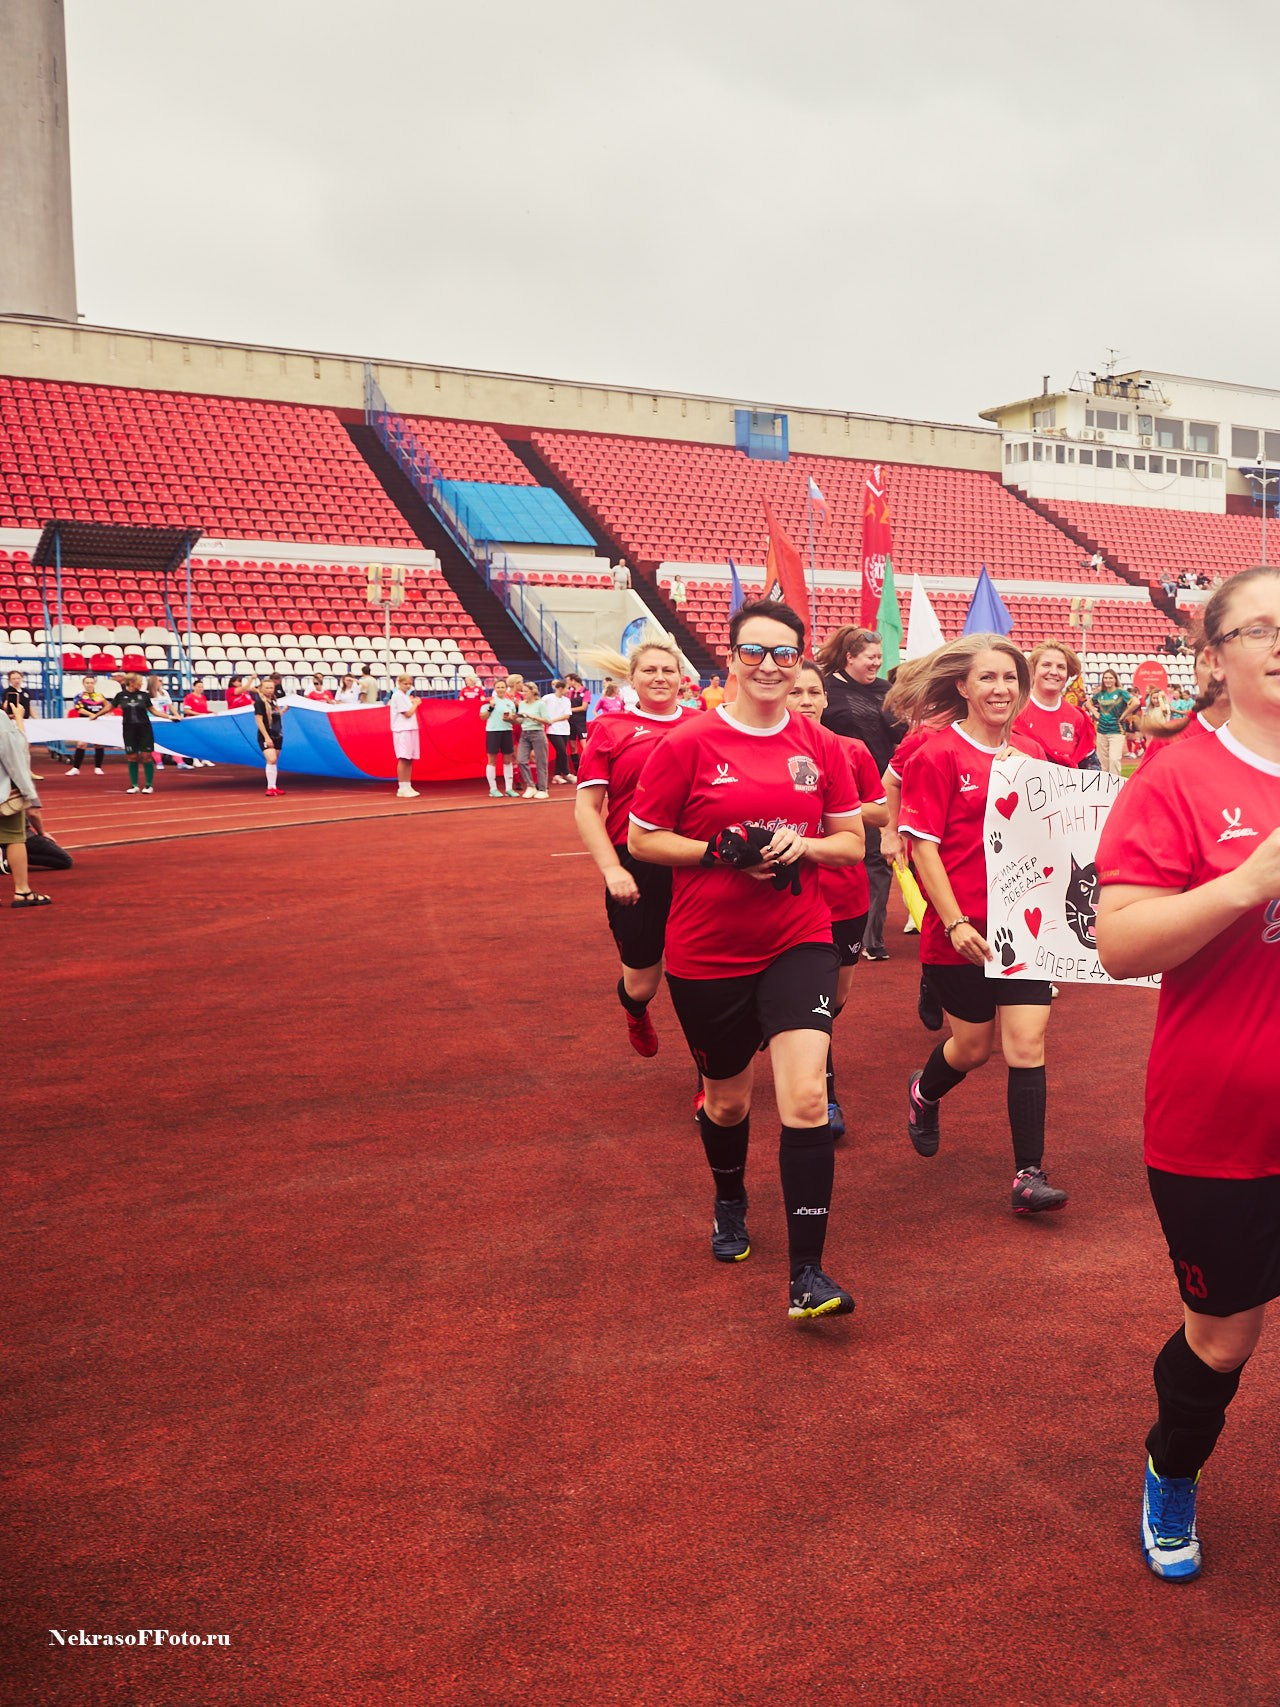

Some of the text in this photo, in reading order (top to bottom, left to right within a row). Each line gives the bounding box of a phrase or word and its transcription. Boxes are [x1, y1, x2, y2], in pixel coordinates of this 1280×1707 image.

[1025, 768, 1125, 812] ВЛАДИМ
[1042, 805, 1109, 839] ПАНТ
[1003, 871, 1042, 907] ПОБЕДА
[793, 1206, 829, 1215] JÖGEL
[1179, 1260, 1208, 1299] 23
